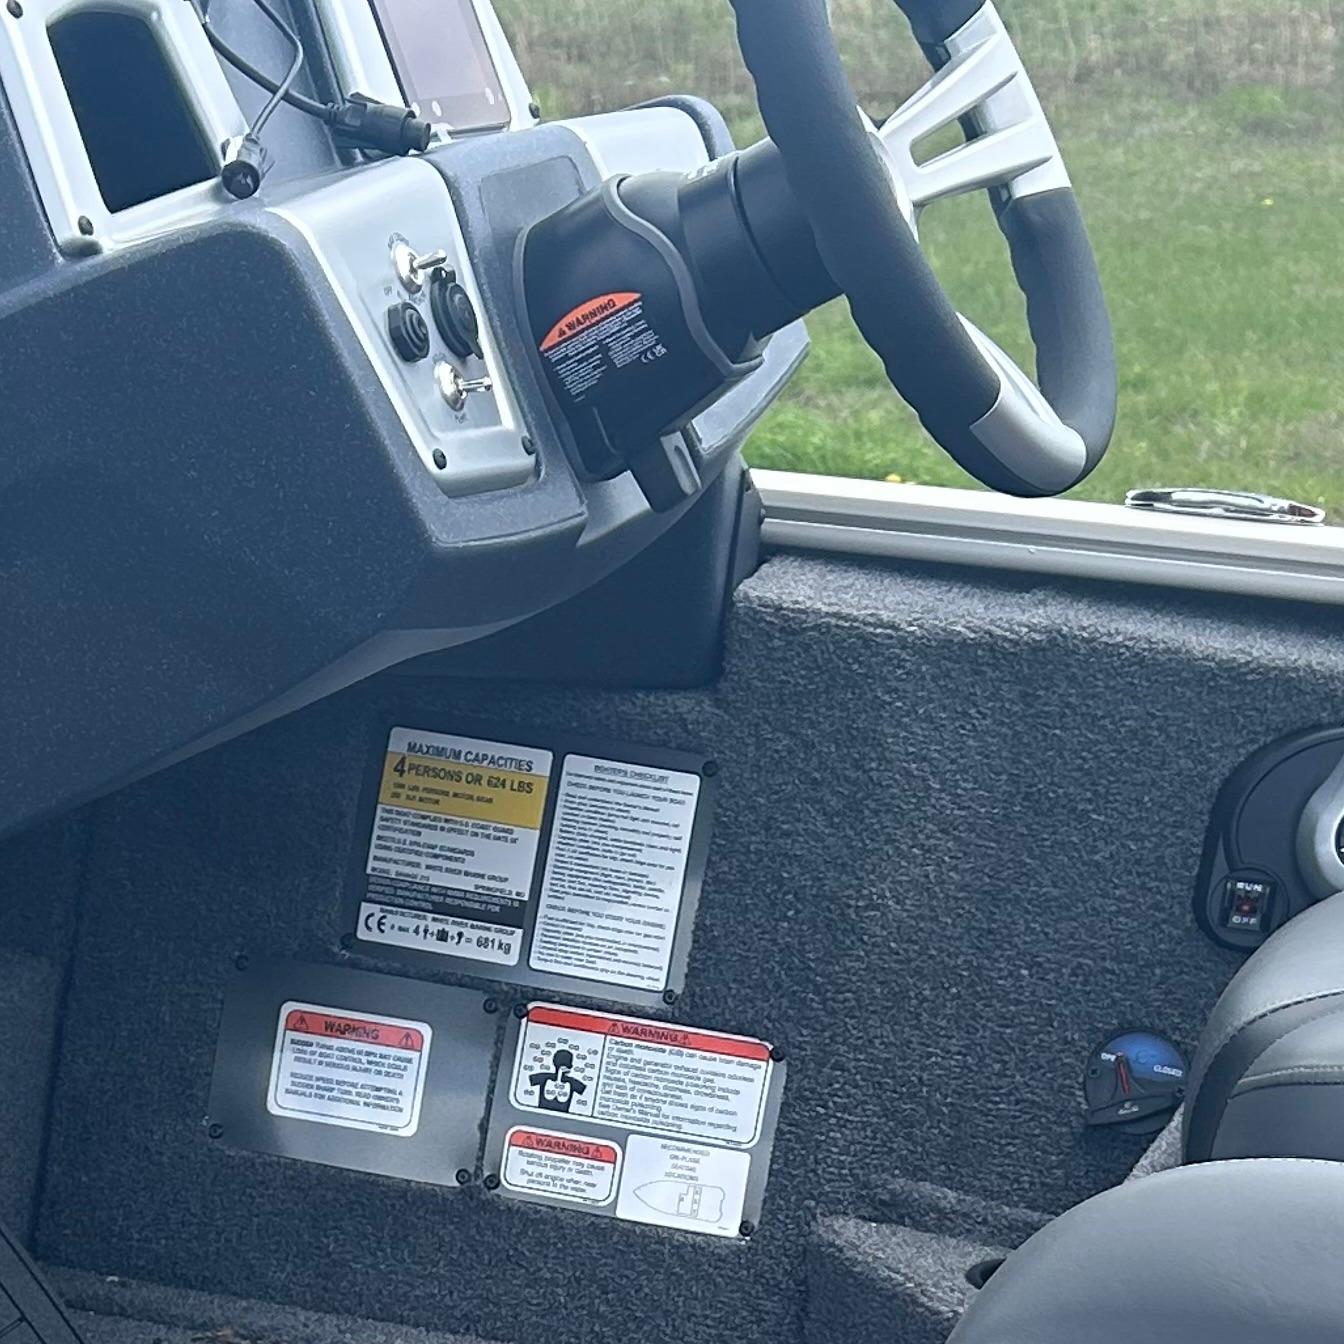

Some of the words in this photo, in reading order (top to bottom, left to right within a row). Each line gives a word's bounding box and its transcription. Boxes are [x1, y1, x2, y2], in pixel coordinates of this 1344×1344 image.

[566, 299, 616, 330] WARNING
[407, 741, 462, 761] MAXIMUM
[464, 751, 533, 773] CAPACITIES
[394, 753, 407, 778] 4
[407, 763, 462, 783] PERSONS
[465, 772, 482, 786] OR
[510, 779, 534, 794] LBS
[323, 1020, 380, 1040] WARNING
[621, 1023, 678, 1043] WARNING
[536, 1137, 590, 1155] WARNING
